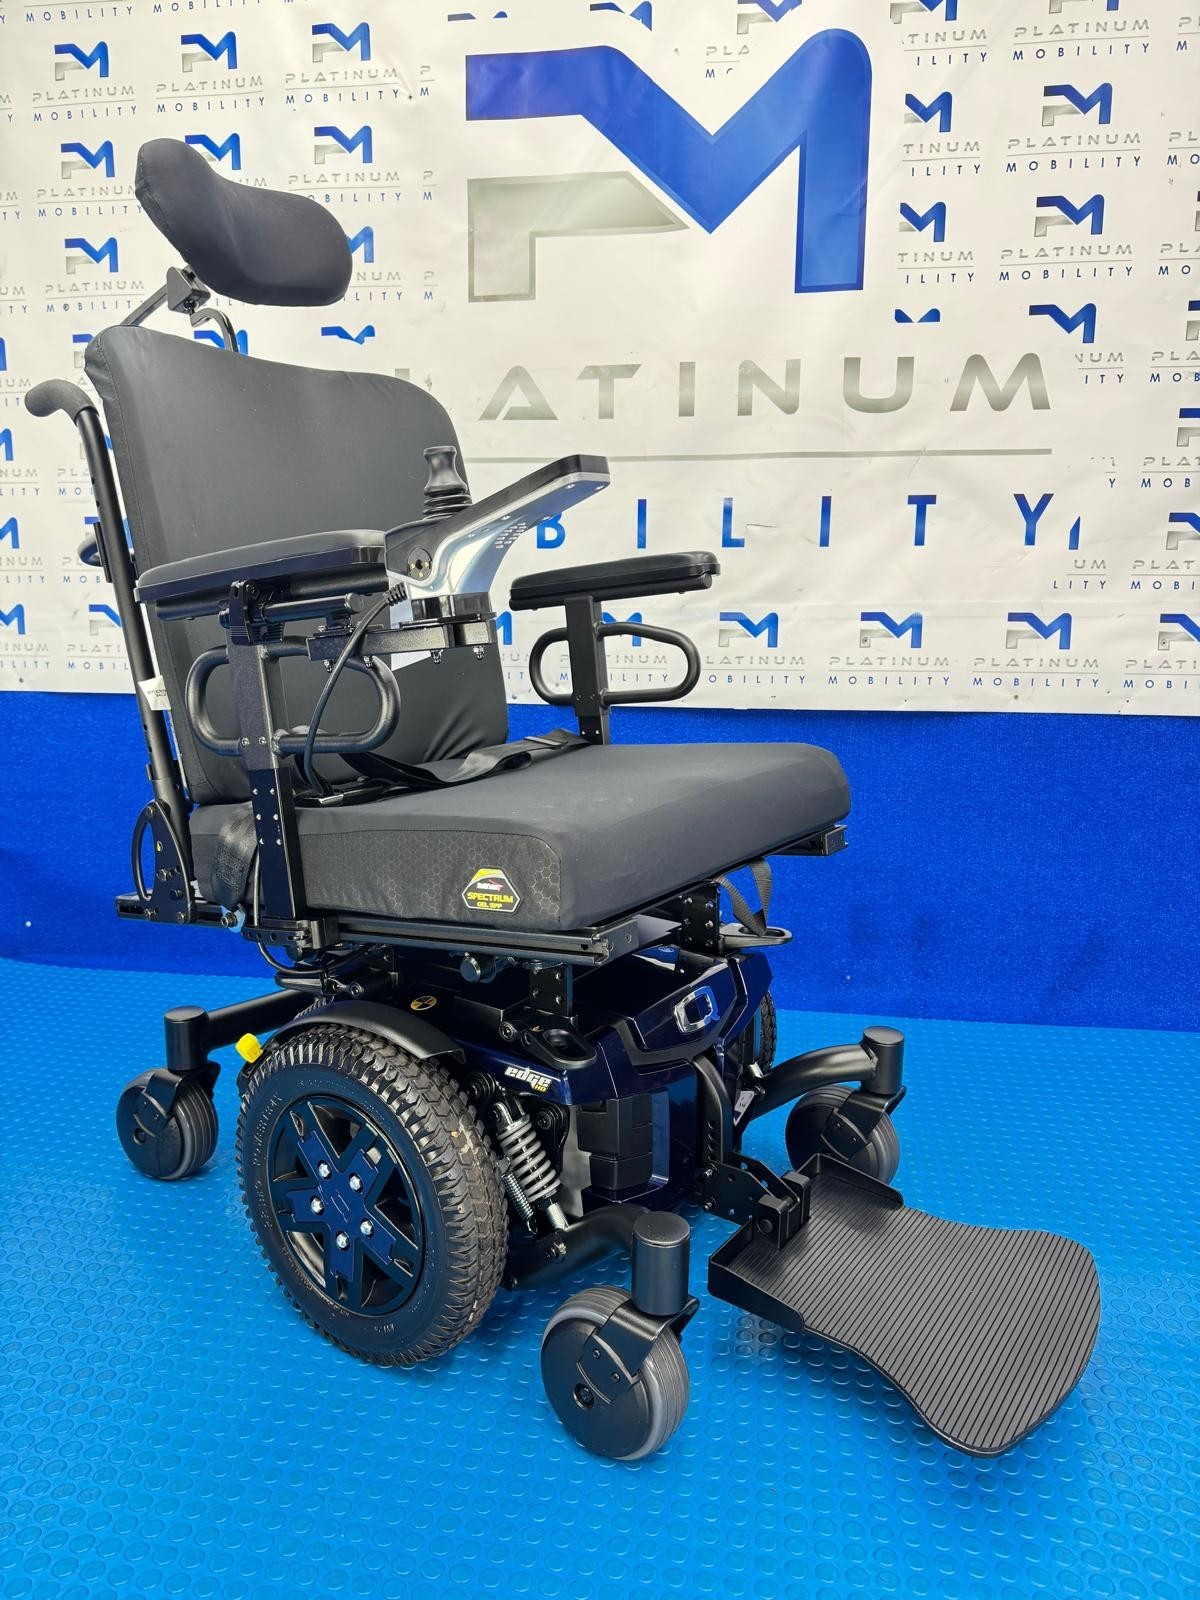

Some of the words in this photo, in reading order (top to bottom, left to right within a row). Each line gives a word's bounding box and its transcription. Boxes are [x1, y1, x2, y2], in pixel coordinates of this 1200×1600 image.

[26, 6, 132, 22] MOBILITY
[1013, 19, 1150, 38] PLATINUM
[1013, 43, 1150, 60] MOBILITY
[285, 67, 398, 84] PLATINUM
[157, 75, 263, 93] PLATINUM
[32, 85, 135, 102] PLATINUM
[286, 89, 399, 104] MOBILITY
[157, 97, 264, 113] MOBILITY
[34, 106, 137, 122] MOBILITY
[1007, 132, 1141, 150] PLATINUM
[1006, 156, 1141, 172] MOBILITY
[288, 171, 400, 185] PLATINUM
[38, 205, 142, 218] MOBILITY
[1000, 244, 1133, 260] PLATINUM
[999, 266, 1132, 281] MOBILITY
[45, 280, 145, 294] PLATINUM
[706, 656, 805, 665] LATINUM
[829, 657, 949, 666] PLATINUM
[973, 657, 1099, 669] PLATINUM
[709, 675, 806, 684] OBILITY
[828, 676, 949, 686] MOBILITY
[973, 677, 1099, 688] MOBILITY
[467, 892, 514, 903] SPECTRUM
[504, 1066, 552, 1090] edge
[534, 1084, 547, 1093] HD
